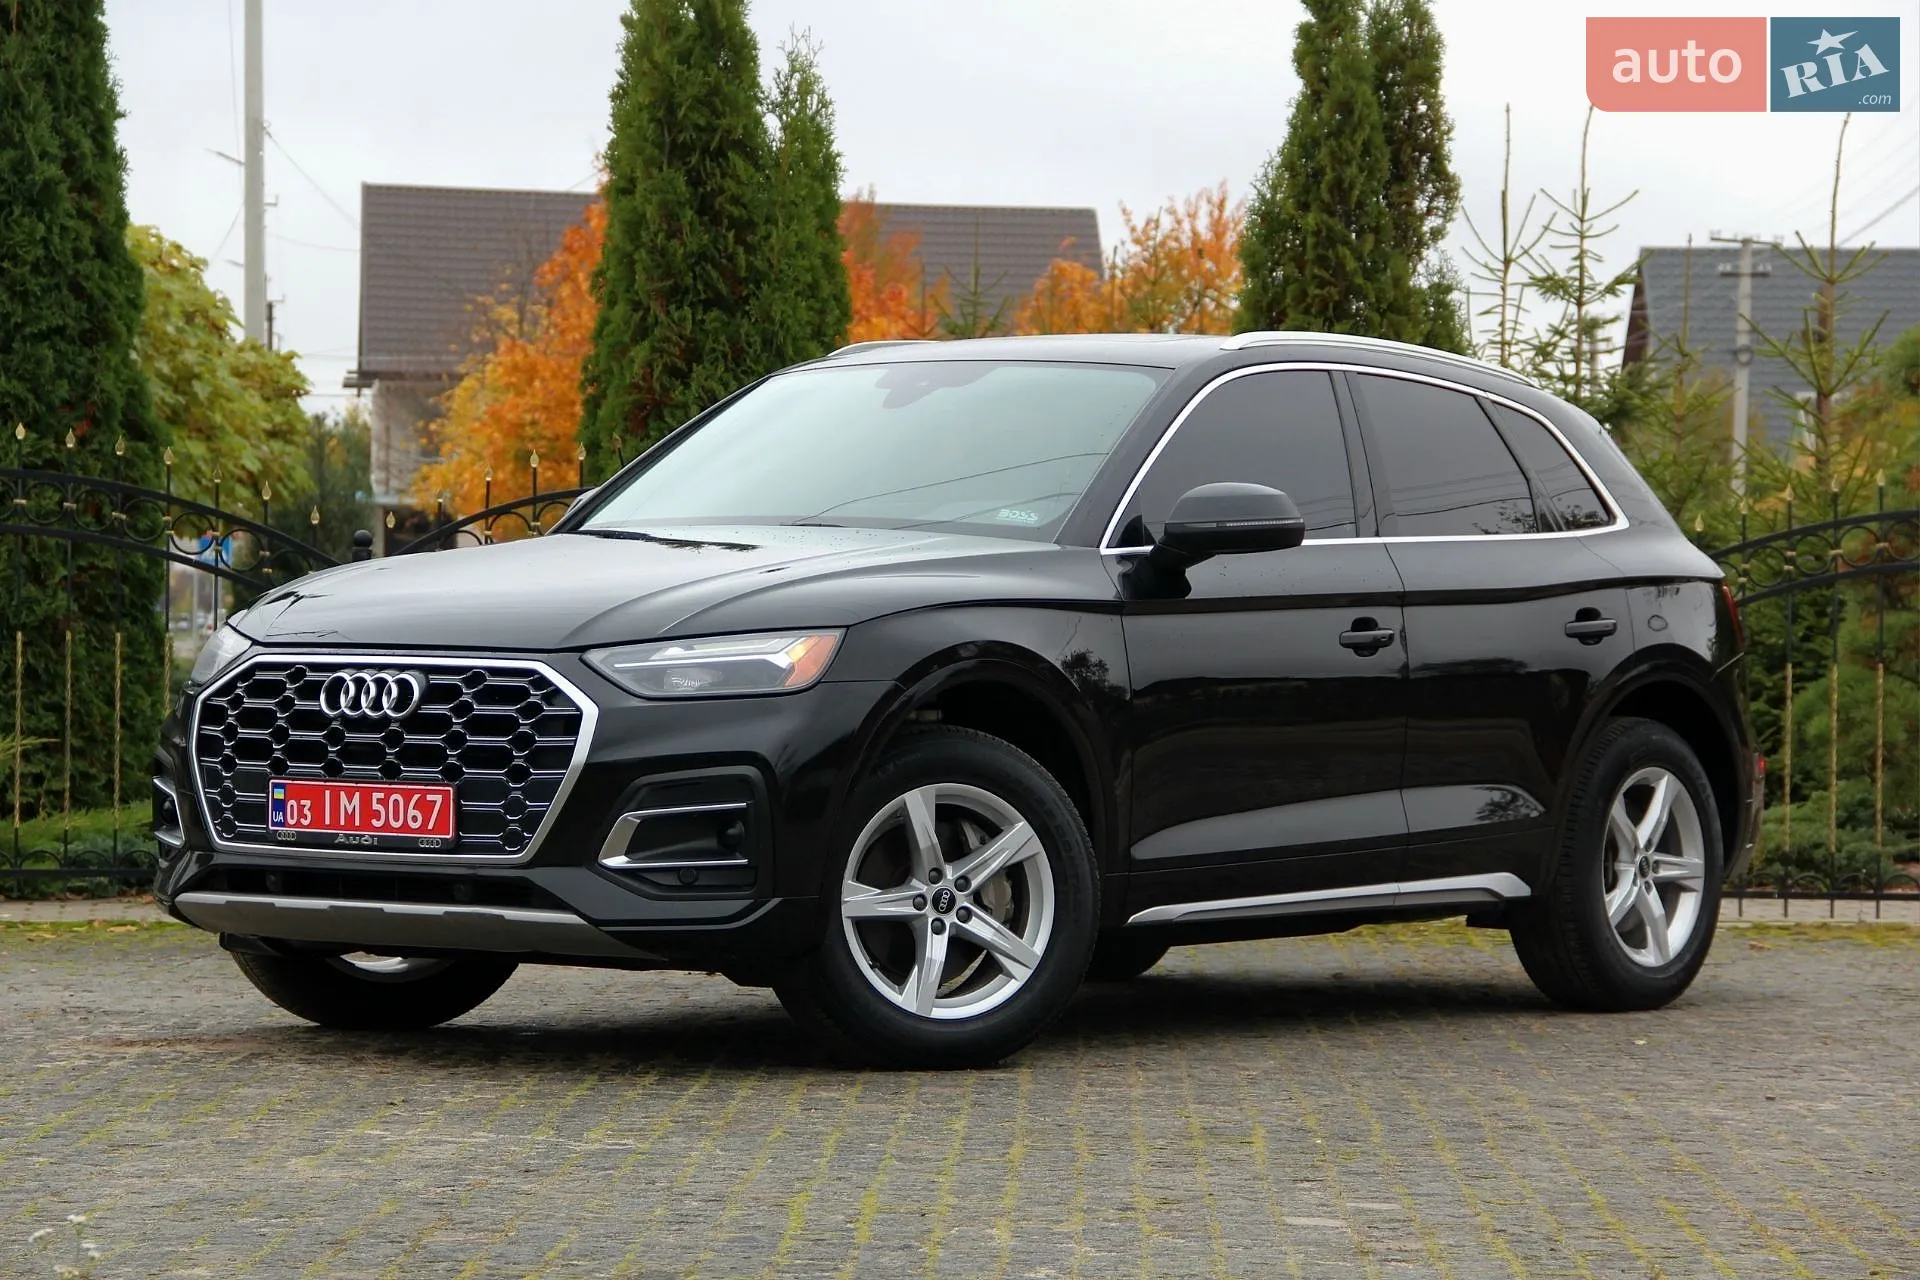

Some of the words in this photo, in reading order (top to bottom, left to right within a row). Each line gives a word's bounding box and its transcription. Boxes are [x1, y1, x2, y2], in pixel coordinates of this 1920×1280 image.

[286, 799, 312, 826] 03
[324, 789, 360, 827] IM
[370, 791, 443, 830] 5067
[272, 810, 284, 823] UA
[334, 833, 378, 846] Audi
